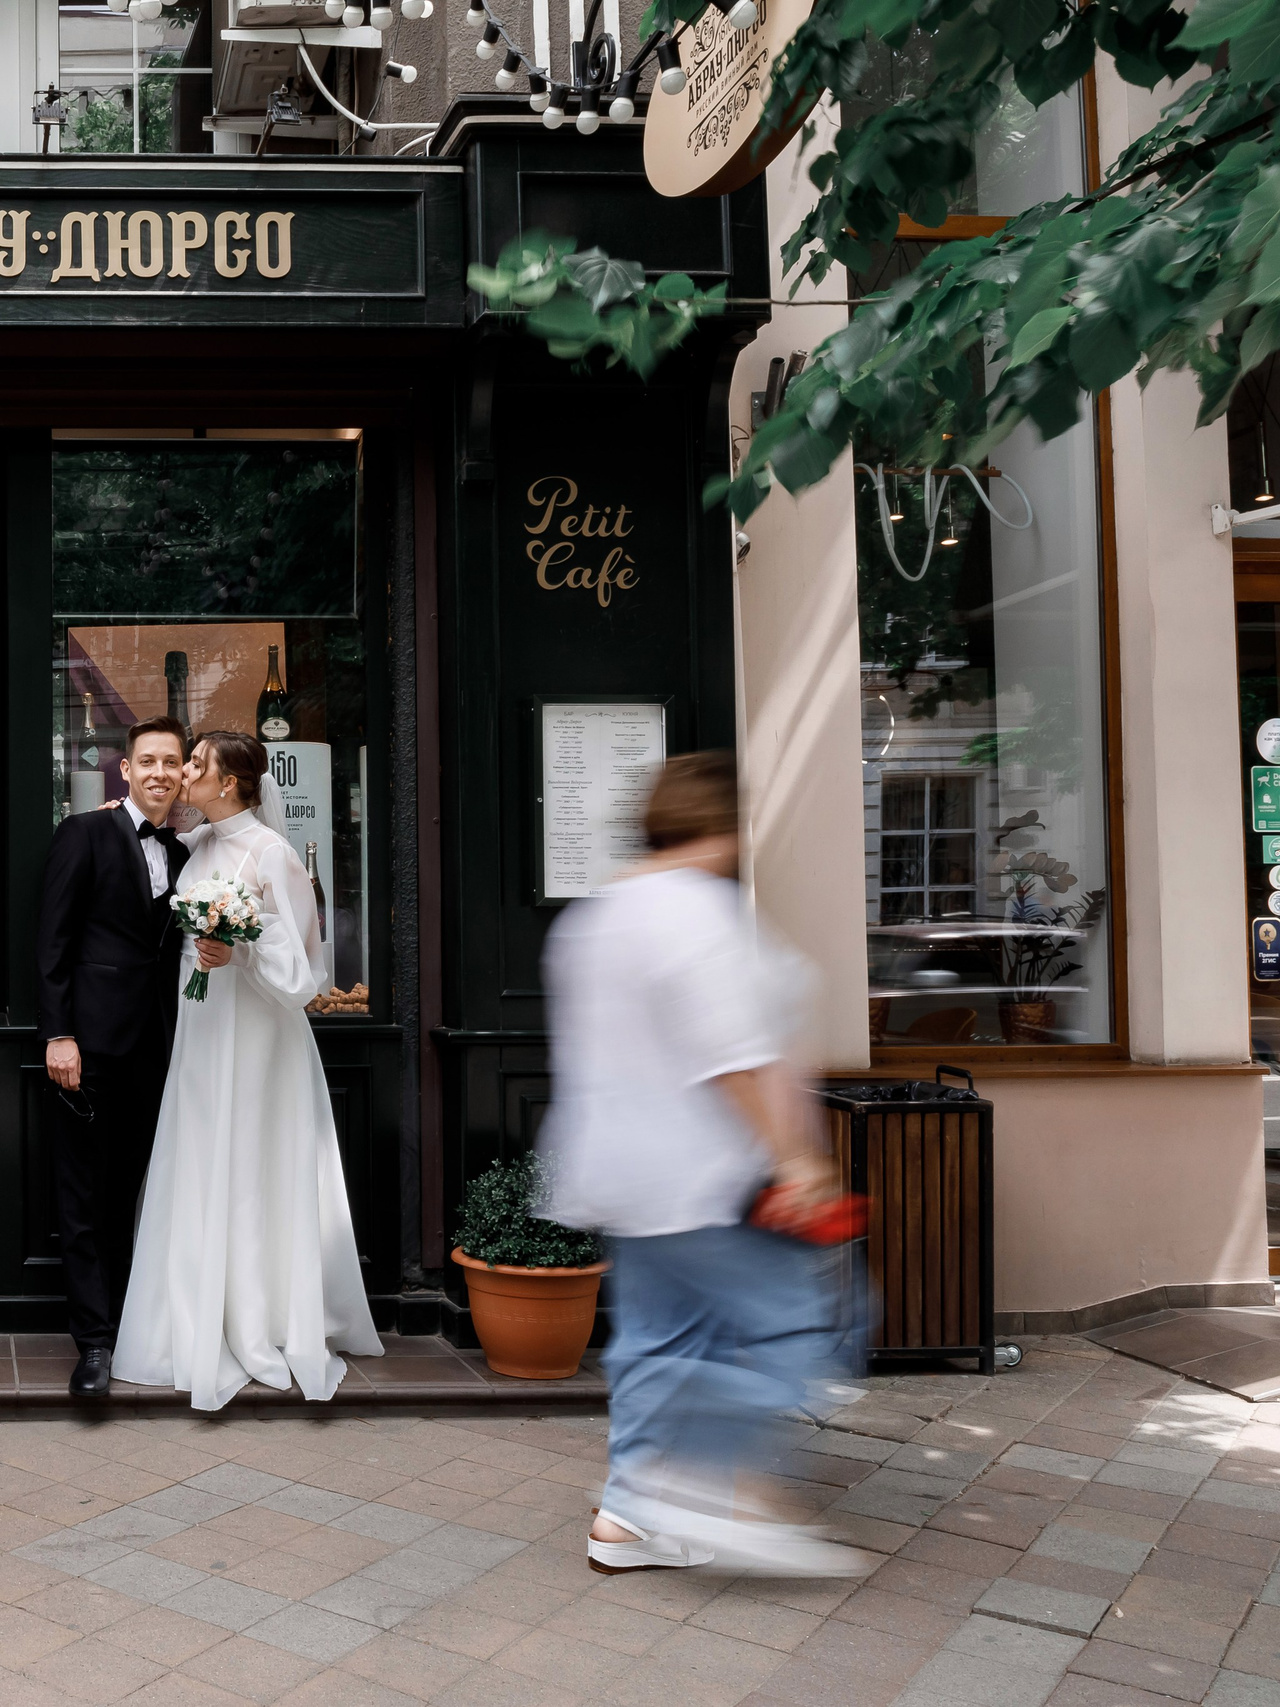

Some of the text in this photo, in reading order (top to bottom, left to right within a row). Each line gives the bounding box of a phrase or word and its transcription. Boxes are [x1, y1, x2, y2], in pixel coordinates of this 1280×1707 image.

[687, 47, 724, 112] АБРАУ
[695, 86, 719, 119] РУССКИЙ
[746, 41, 759, 63] ДОМ
[50, 210, 296, 283] ДЮРСО
[523, 475, 635, 538] Petit
[525, 539, 641, 608] Cafè
[270, 751, 297, 787] 150
[285, 803, 316, 819] ДЮРСО
[1258, 952, 1280, 960] Премия
